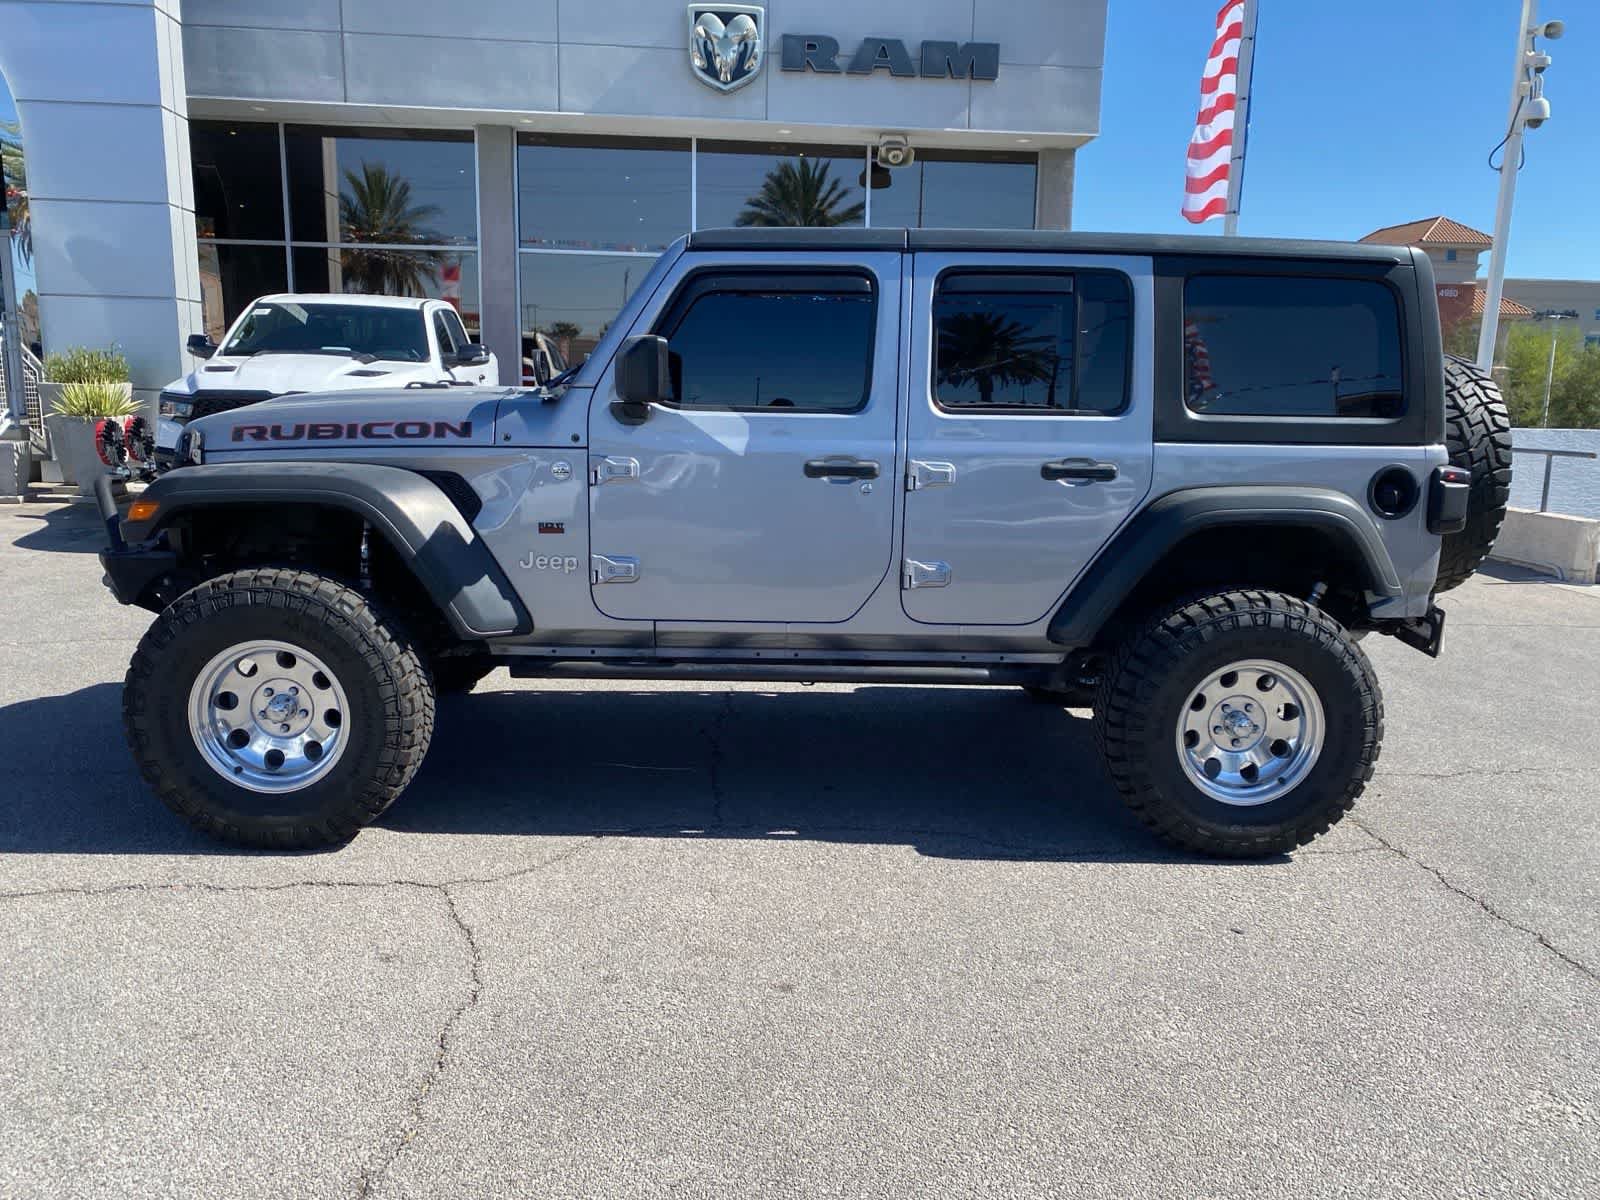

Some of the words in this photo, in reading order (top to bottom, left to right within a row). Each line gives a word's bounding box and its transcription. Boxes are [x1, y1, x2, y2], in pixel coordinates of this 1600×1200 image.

[780, 33, 1000, 81] RAM
[231, 421, 473, 442] RUBICON
[519, 551, 578, 574] Jeep
